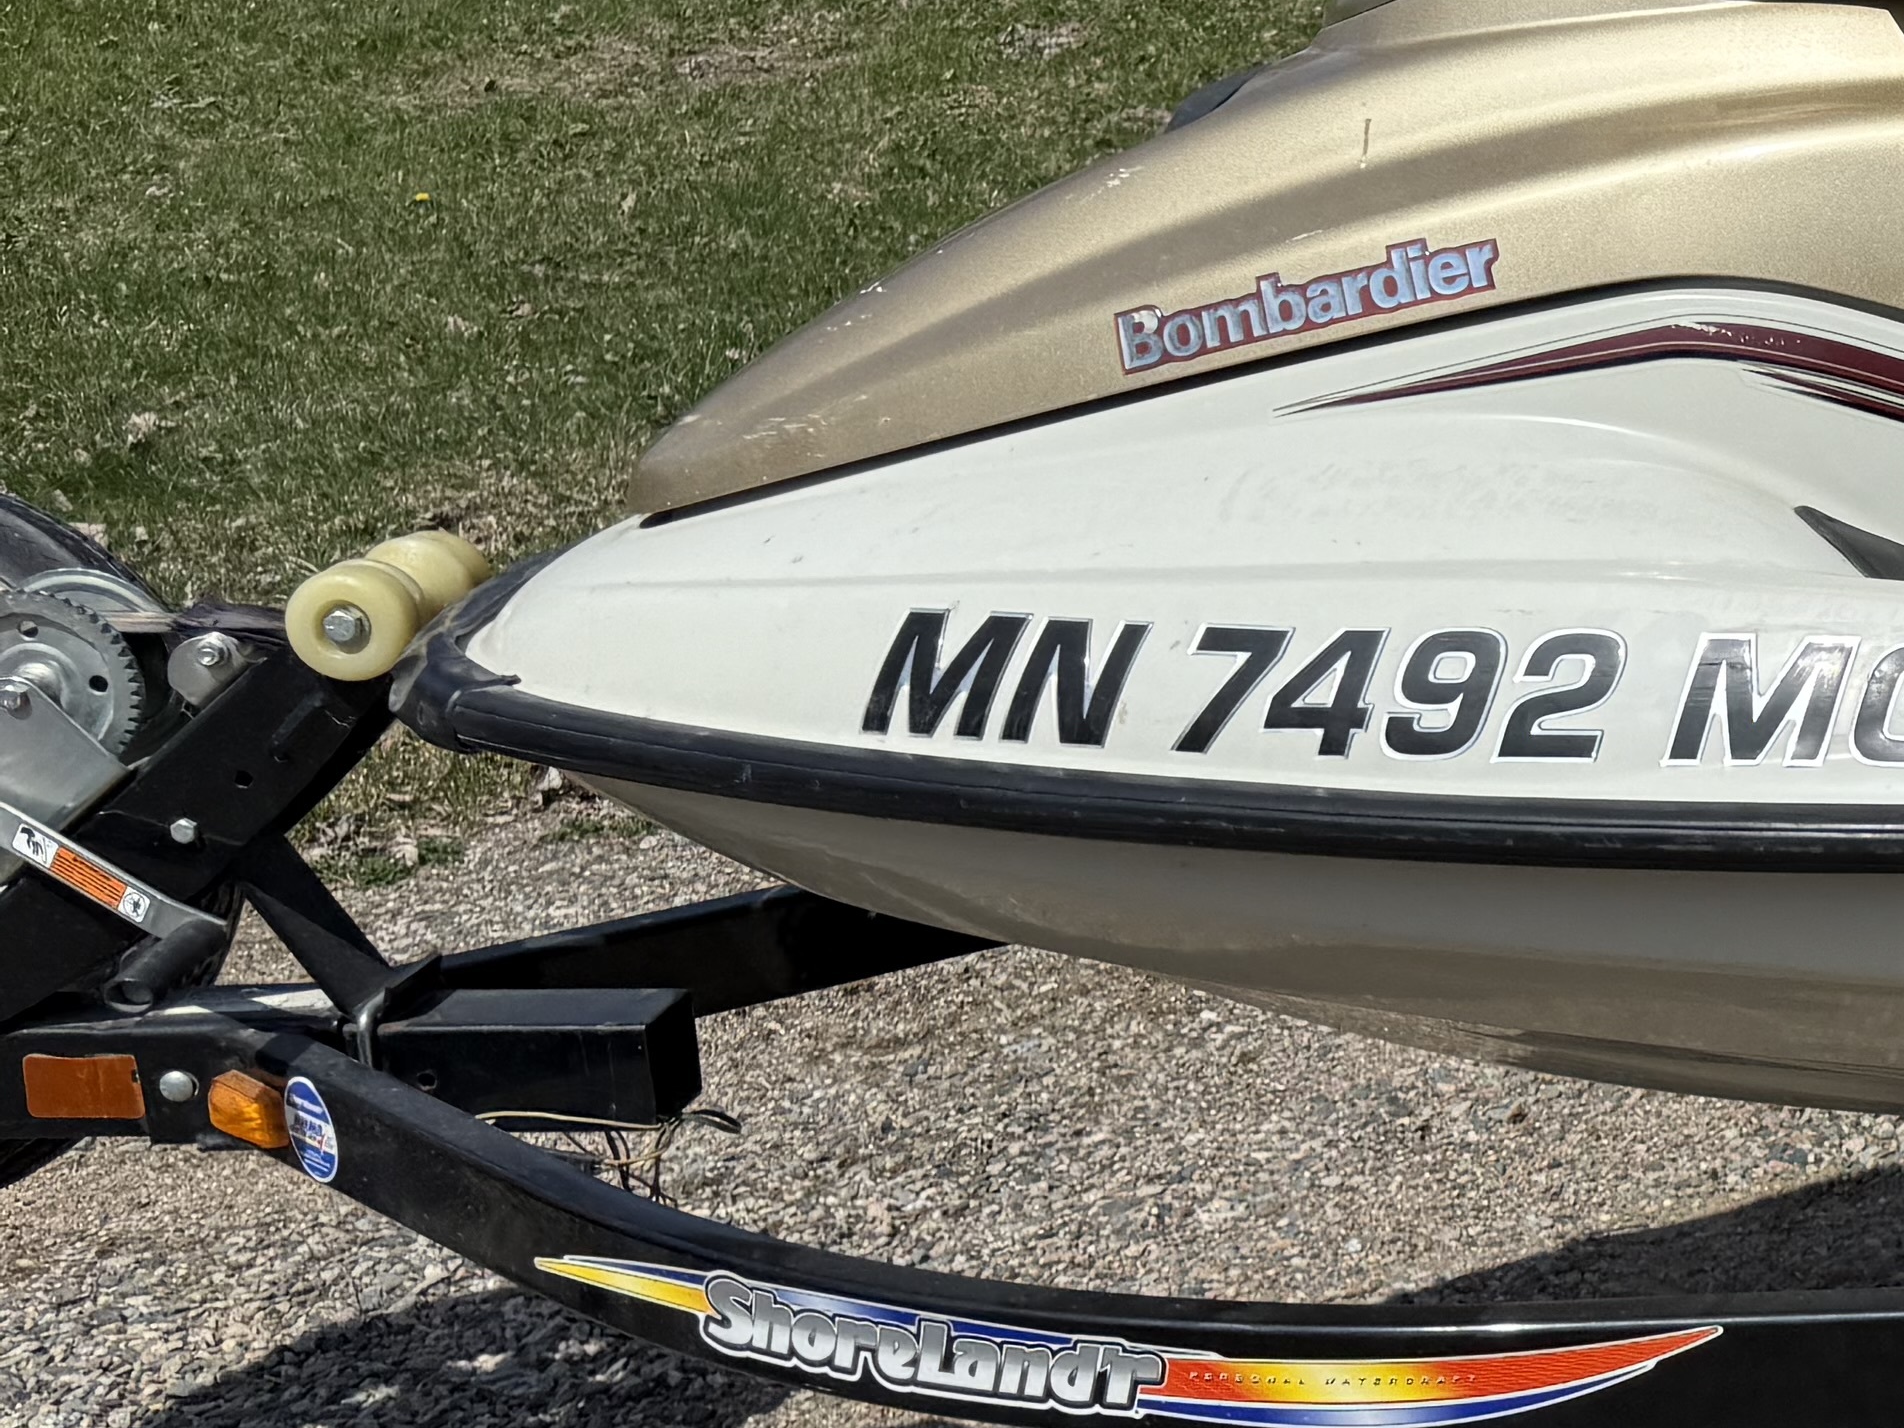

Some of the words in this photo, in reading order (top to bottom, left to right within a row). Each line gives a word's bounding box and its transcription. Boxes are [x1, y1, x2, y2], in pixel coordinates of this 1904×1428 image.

[1115, 239, 1498, 373] Bombardier
[860, 607, 1154, 745] MN
[1172, 625, 1628, 767] 7492
